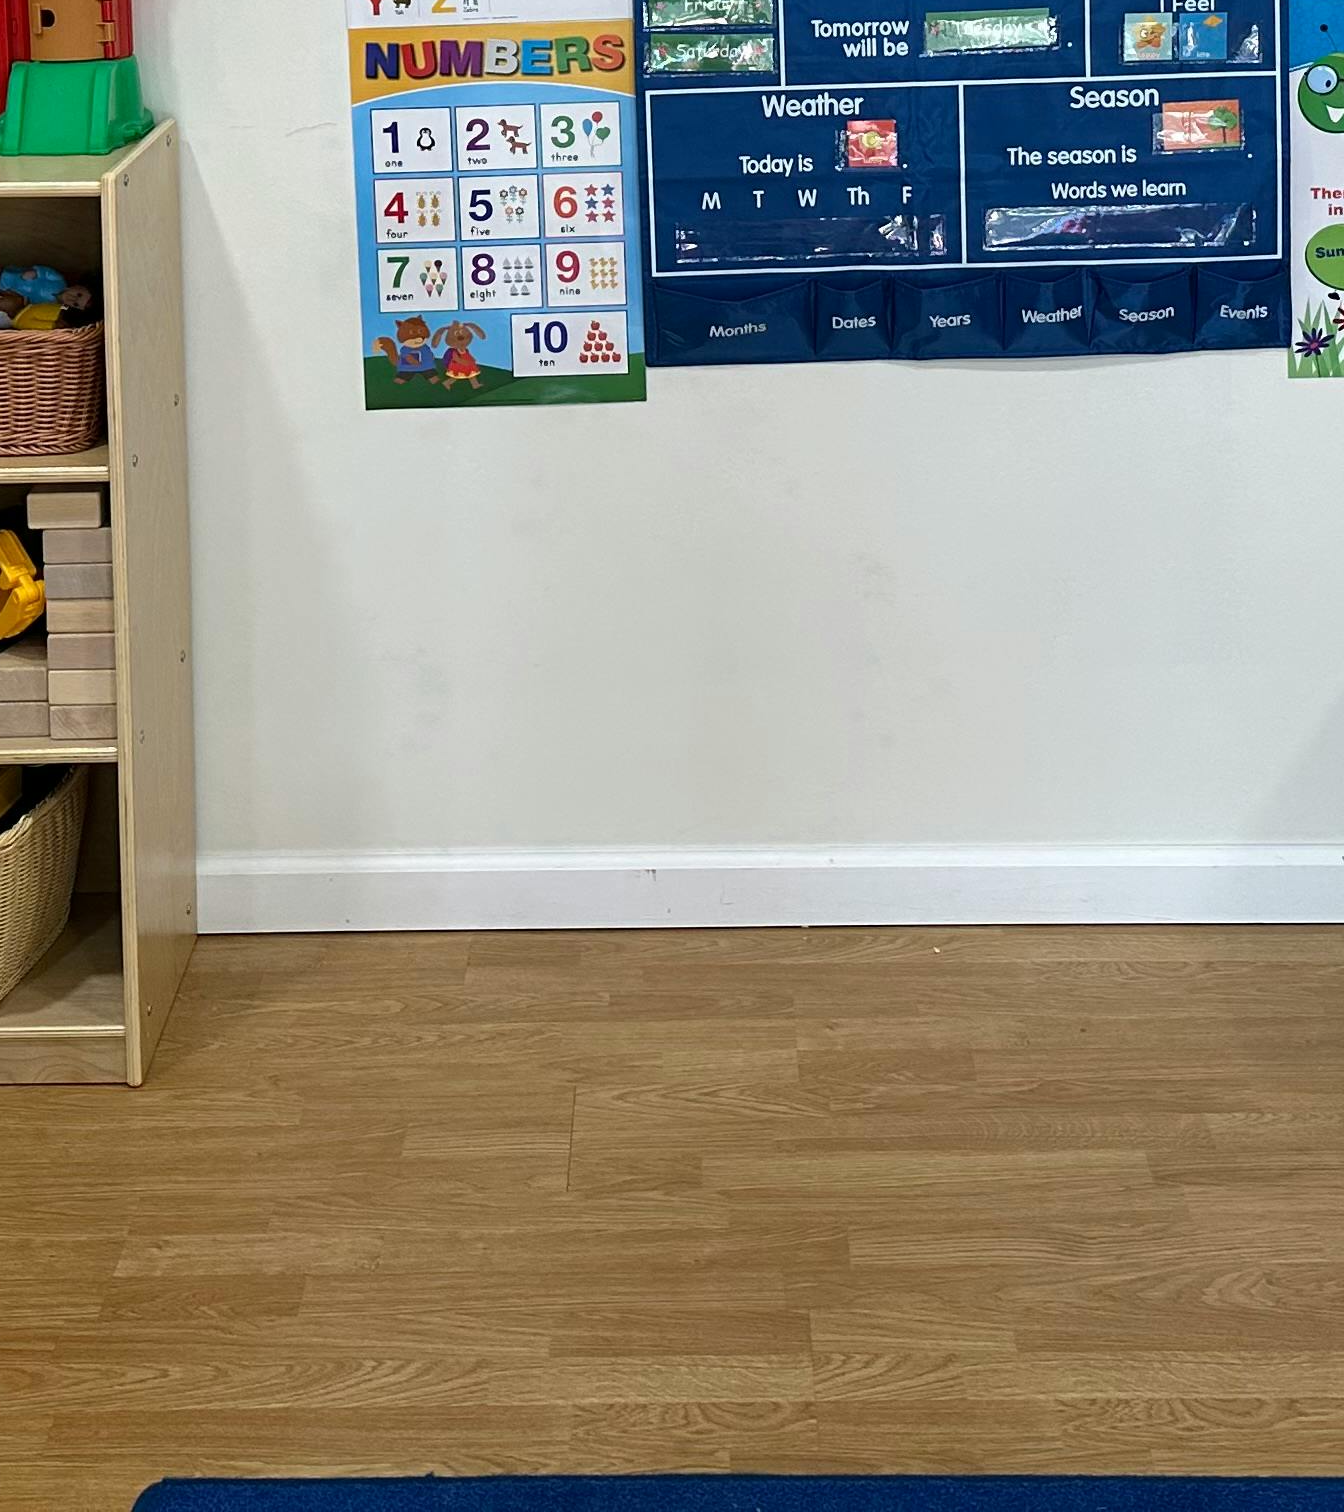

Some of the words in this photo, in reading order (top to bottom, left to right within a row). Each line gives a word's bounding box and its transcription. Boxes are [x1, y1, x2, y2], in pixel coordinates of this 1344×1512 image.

[810, 19, 909, 38] Tomorrow
[364, 33, 625, 79] NUMBERS
[843, 39, 877, 58] will
[883, 38, 909, 57] be
[761, 93, 864, 119] Weather
[1069, 85, 1159, 109] Season
[382, 121, 399, 153] 1
[465, 118, 491, 151] 2
[551, 116, 576, 149] 3
[384, 160, 403, 168] one
[467, 156, 488, 166] two
[551, 152, 579, 162] three
[1006, 146, 1042, 166] The
[1047, 149, 1116, 166] season
[1121, 145, 1137, 163] is
[1051, 182, 1106, 200] Words
[1111, 184, 1138, 198] we
[1142, 179, 1187, 196] learn
[832, 315, 876, 330] Dates
[929, 313, 972, 329] Years
[1220, 304, 1268, 320] Events
[524, 320, 568, 354] 10
[539, 358, 556, 367] ten
